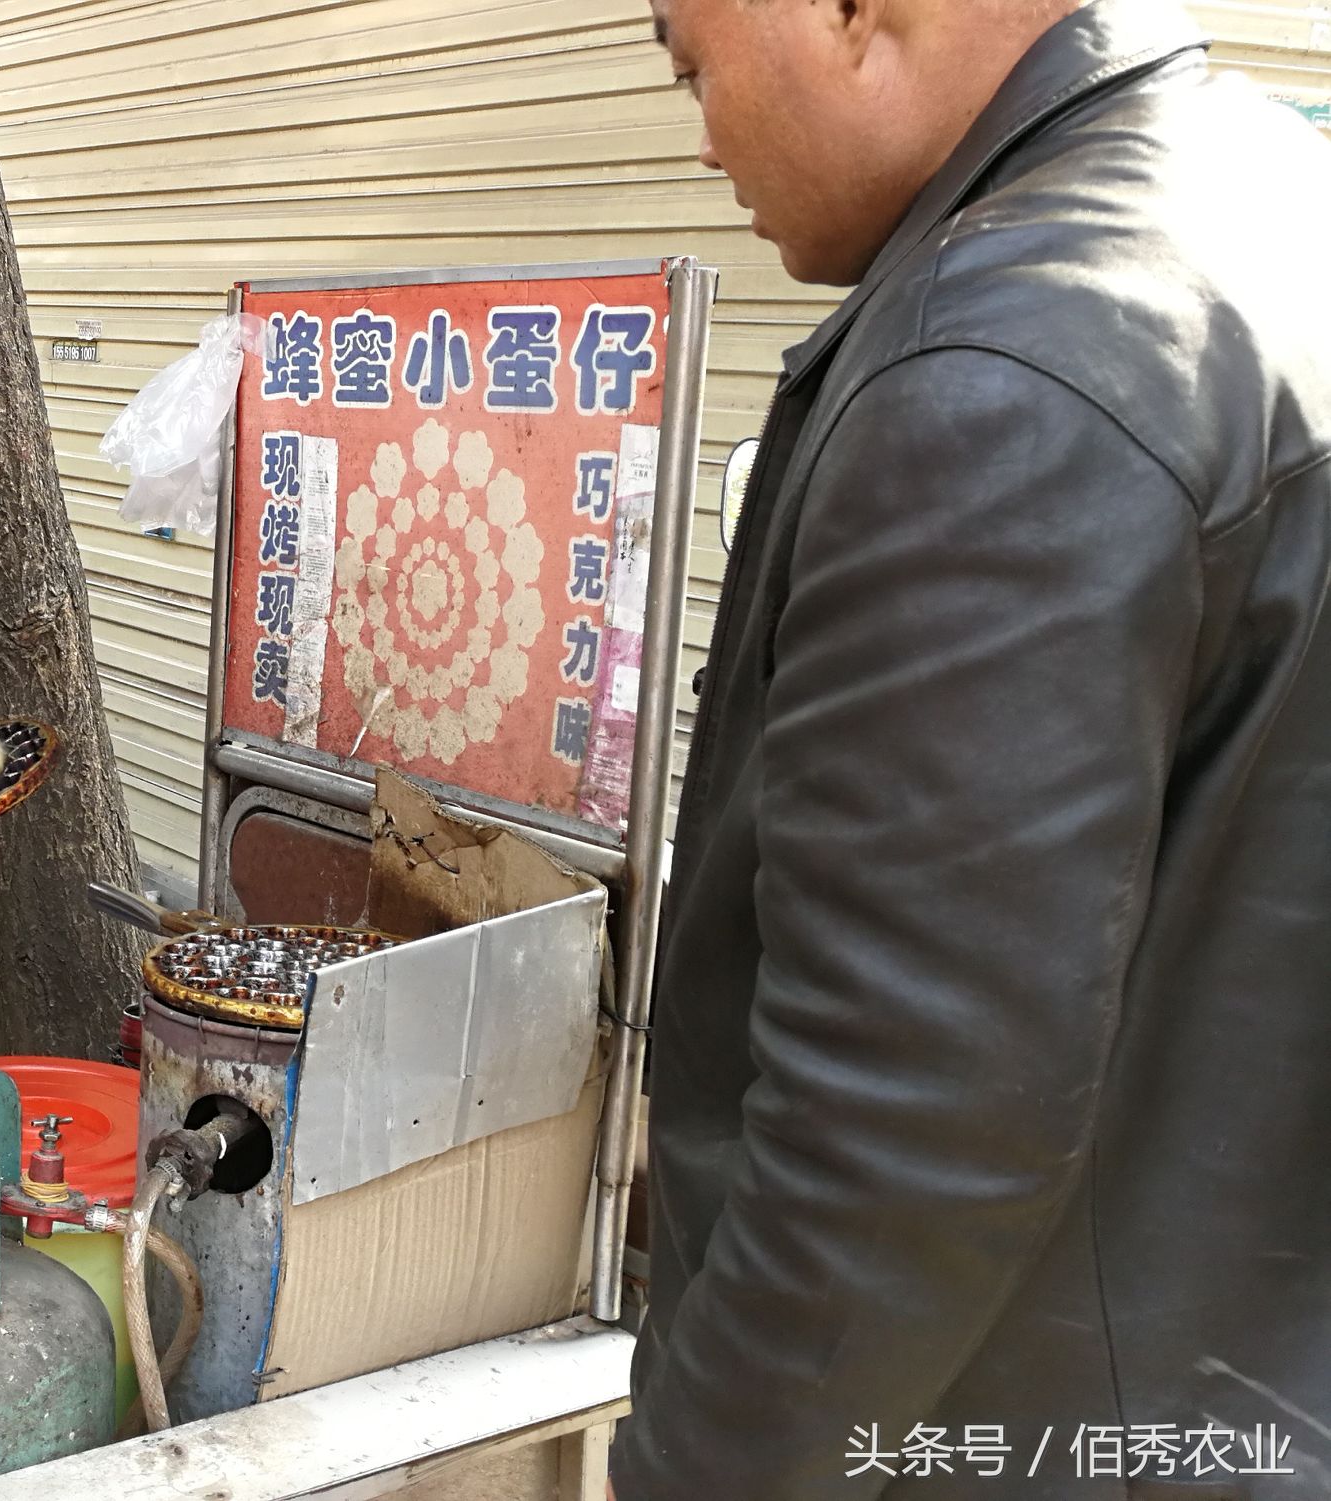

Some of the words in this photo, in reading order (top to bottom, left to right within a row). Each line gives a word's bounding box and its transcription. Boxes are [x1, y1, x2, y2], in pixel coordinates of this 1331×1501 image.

[262, 304, 656, 414] 蜂蜜小蛋仔
[253, 430, 303, 708] 现烤现卖
[550, 451, 618, 769] 巧克力味
